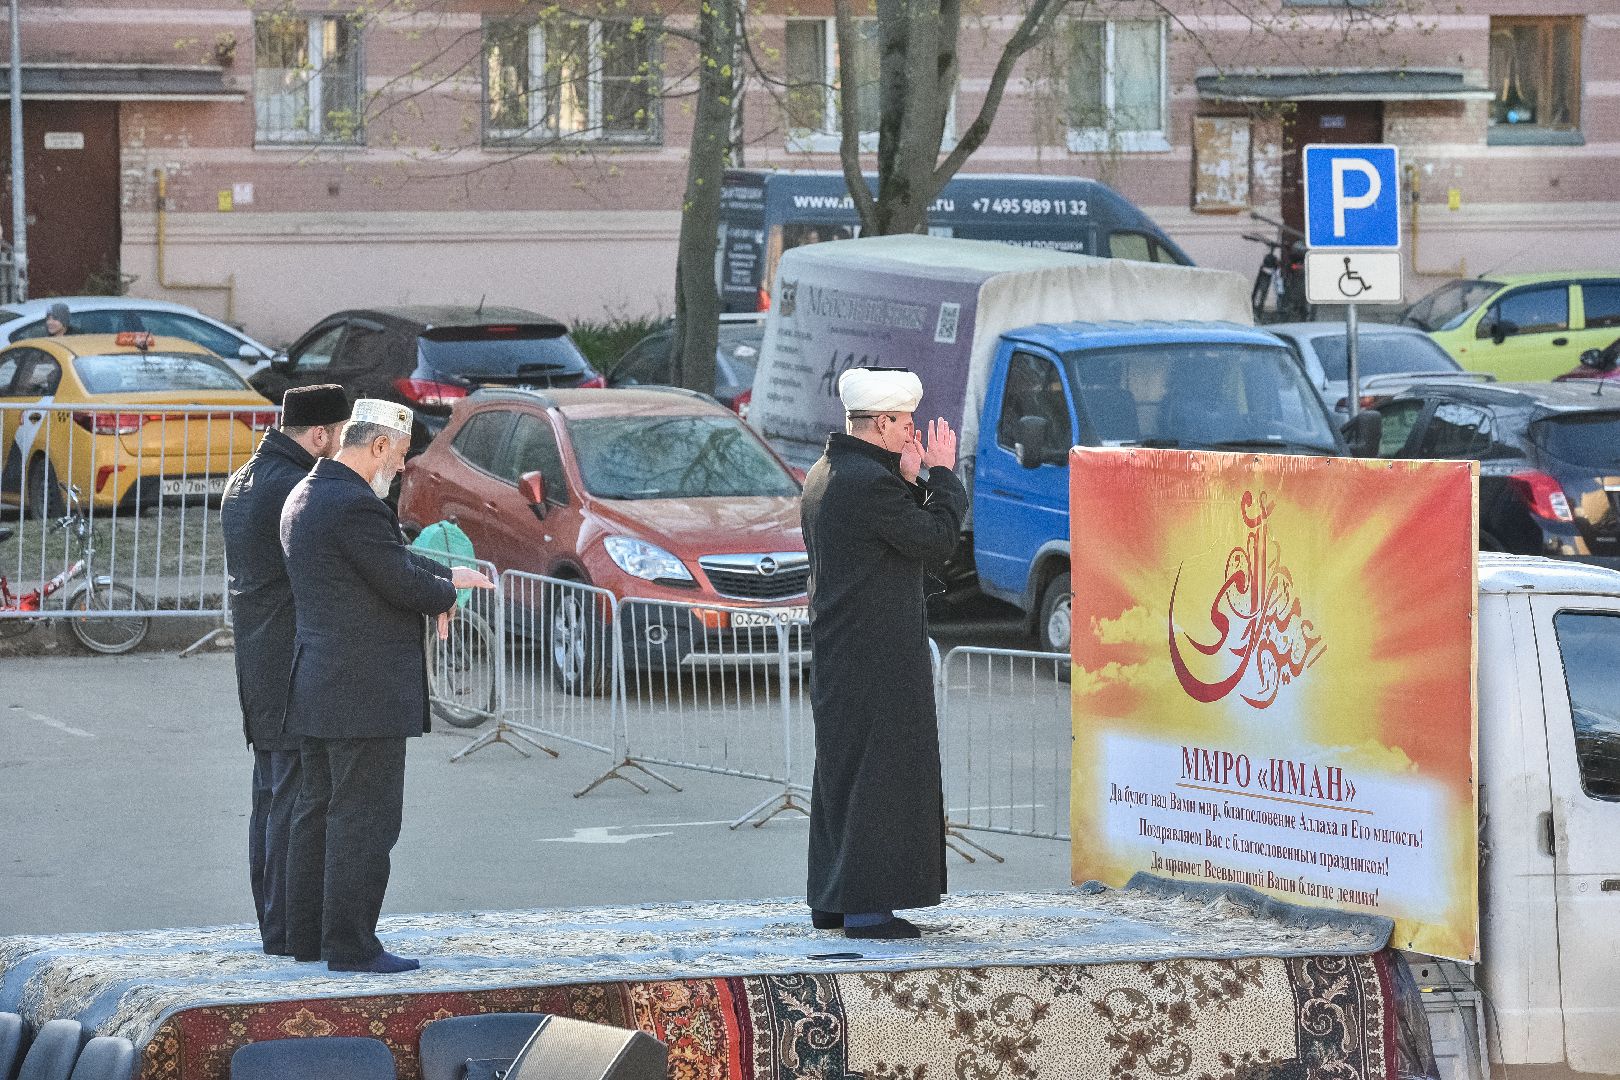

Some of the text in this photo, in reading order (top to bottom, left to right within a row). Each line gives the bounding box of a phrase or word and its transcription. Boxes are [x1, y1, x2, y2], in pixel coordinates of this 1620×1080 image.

[971, 197, 990, 213] +7
[991, 198, 1021, 215] 495
[1021, 198, 1051, 215] 989
[1053, 199, 1067, 216] 11
[1068, 199, 1088, 216] 32
[1331, 158, 1382, 237] P
[1180, 746, 1357, 802] ММРО «ИМАН»
[1109, 783, 1122, 805] Да
[1124, 785, 1149, 808] будет
[1151, 793, 1167, 811] над
[1170, 792, 1196, 813] Вами
[1198, 802, 1221, 821] мир,
[1223, 800, 1296, 829] благословение
[1299, 812, 1338, 836] Аллаха
[1351, 819, 1371, 840] Его
[1373, 828, 1423, 848] милость!
[1138, 817, 1203, 845] Поздравляем
[1205, 828, 1223, 849] Вас
[1232, 833, 1317, 866] благословенным
[1319, 852, 1389, 876] праздником!
[1150, 851, 1379, 907] Да примет Всевышний Ваши благие деяния!
